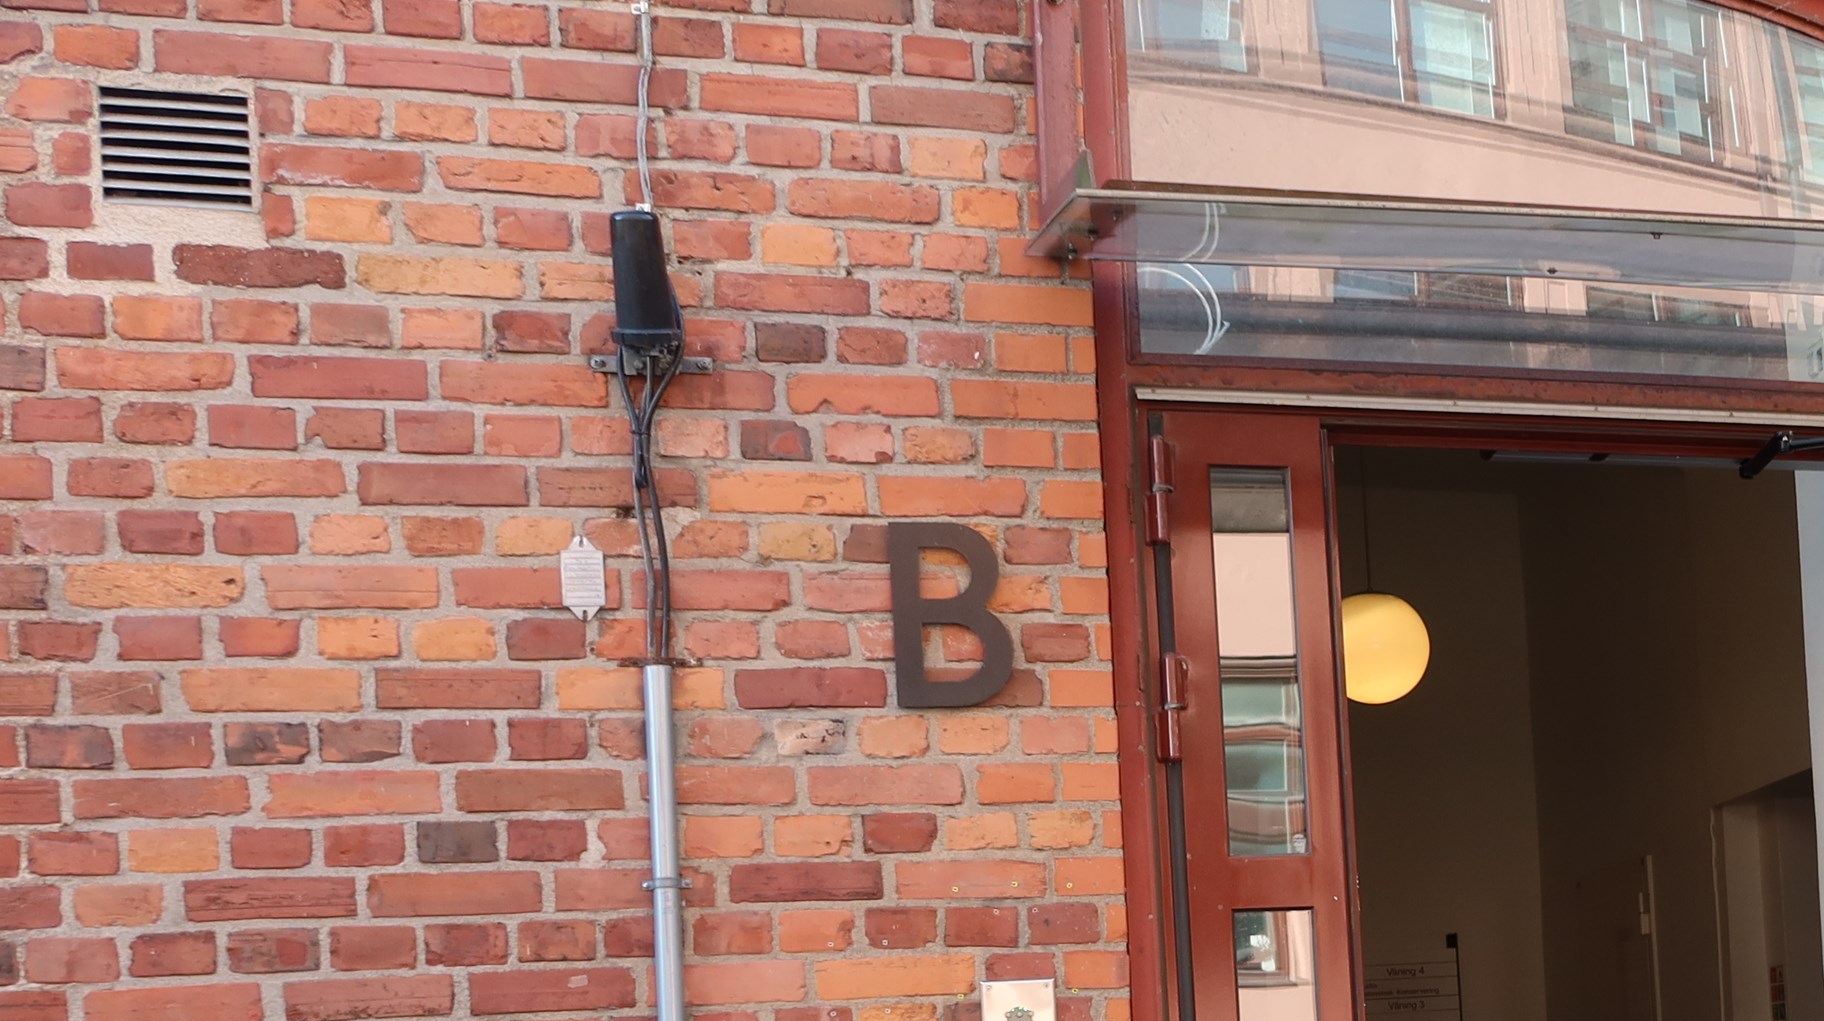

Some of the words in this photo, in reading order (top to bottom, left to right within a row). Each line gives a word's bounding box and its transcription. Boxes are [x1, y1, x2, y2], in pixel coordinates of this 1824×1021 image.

[888, 522, 1014, 708] B
[1418, 966, 1425, 975] 4
[1387, 1000, 1417, 1011] Våning
[1419, 1000, 1425, 1009] 3
